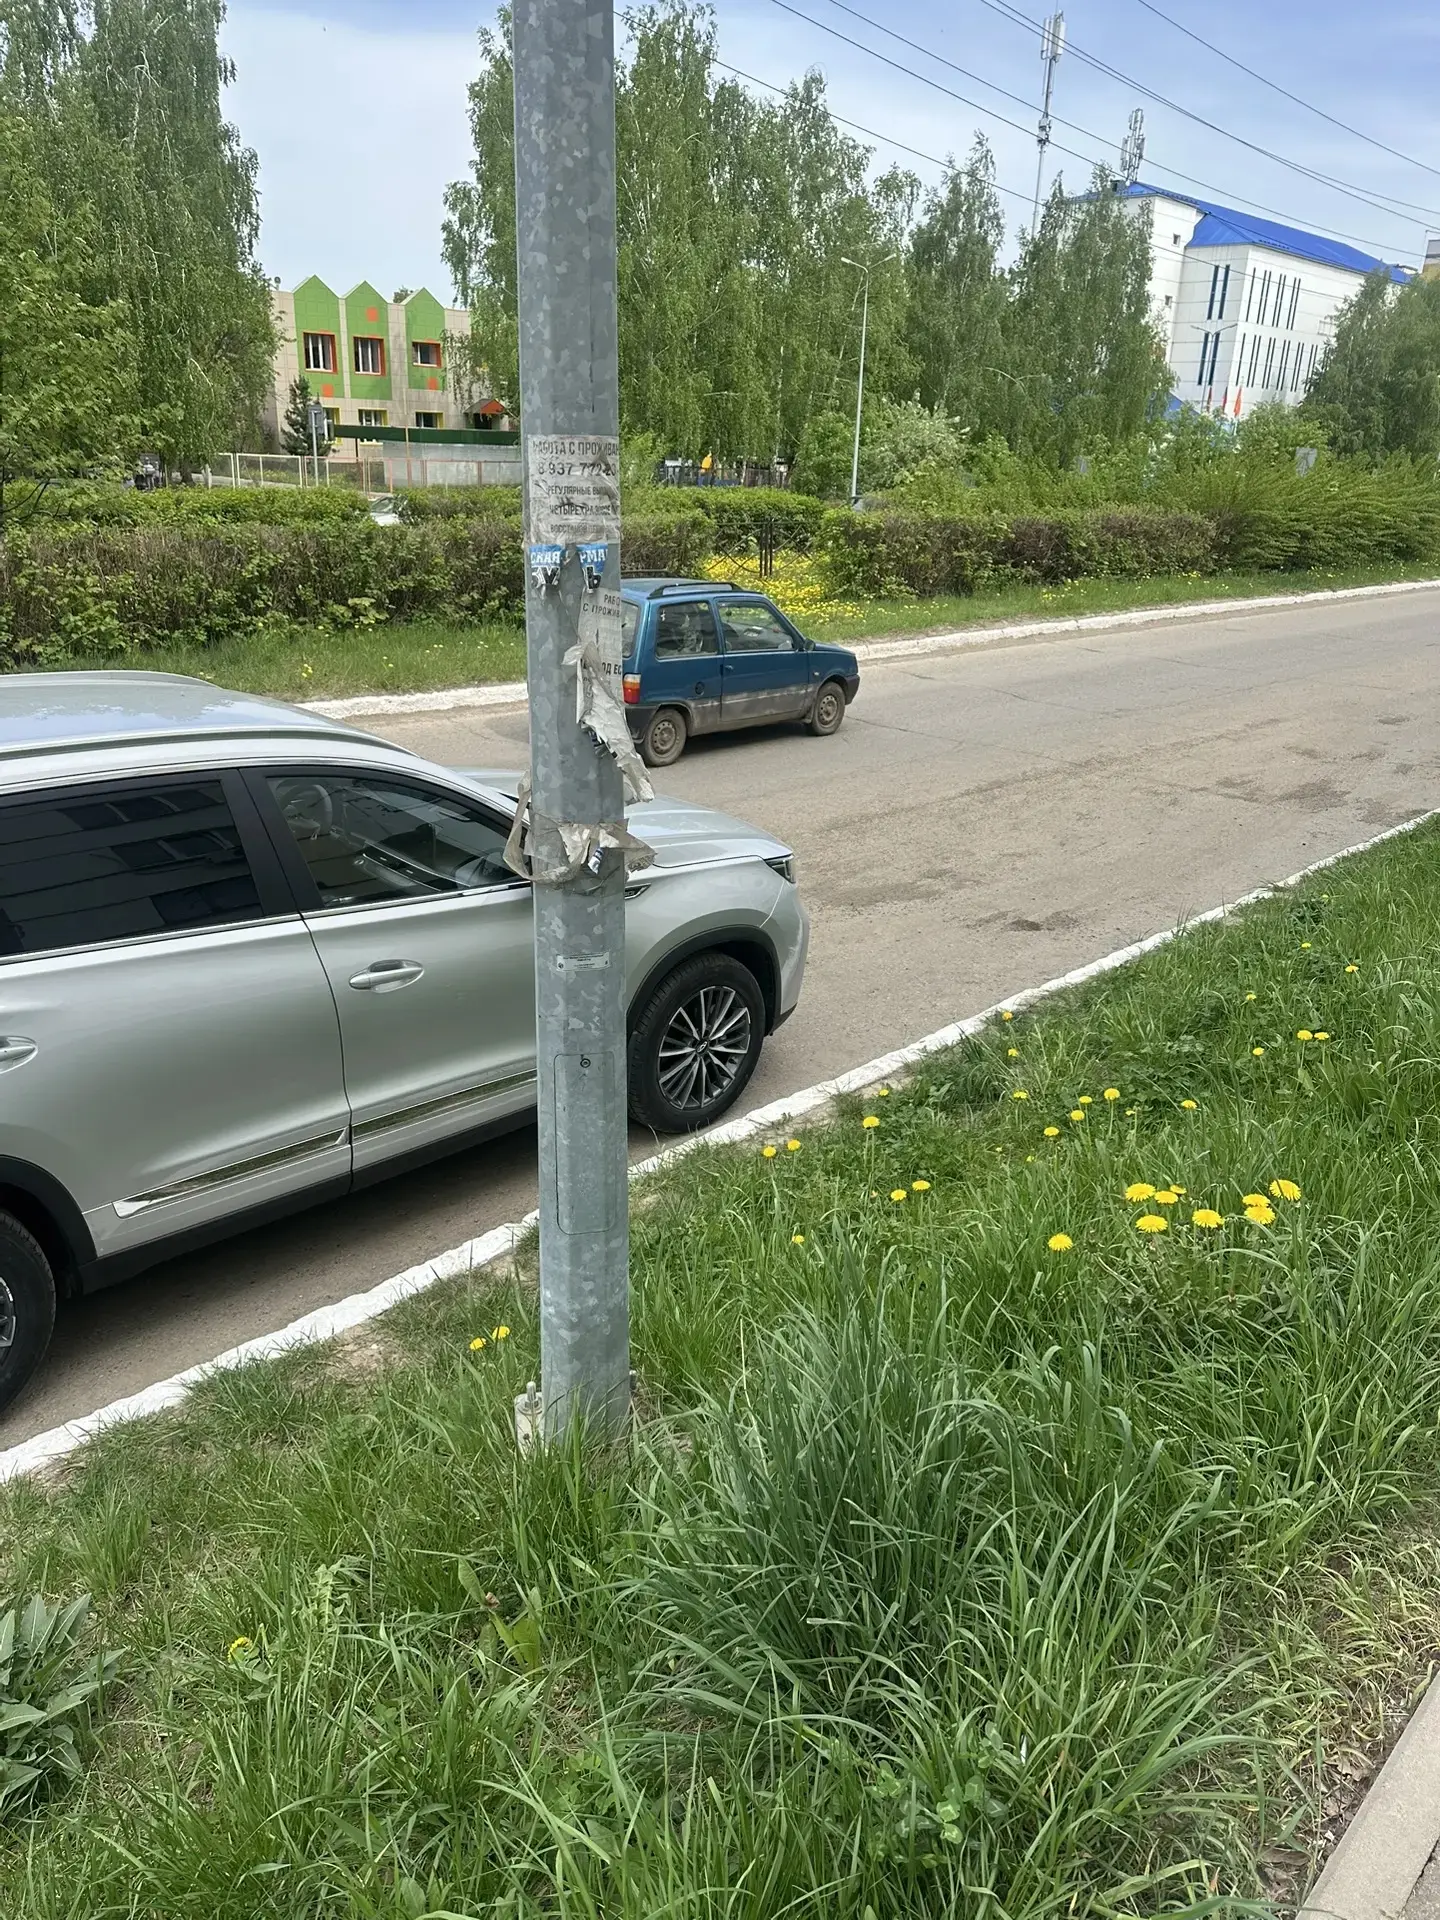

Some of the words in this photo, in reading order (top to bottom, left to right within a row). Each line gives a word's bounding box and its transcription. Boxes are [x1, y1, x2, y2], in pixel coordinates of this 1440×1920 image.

[569, 441, 575, 455] С
[538, 462, 545, 475] 8
[549, 462, 573, 476] 937
[548, 485, 591, 496] РЕГУЛЯРНЫЕ
[579, 548, 608, 563] РМА
[582, 602, 589, 612] С
